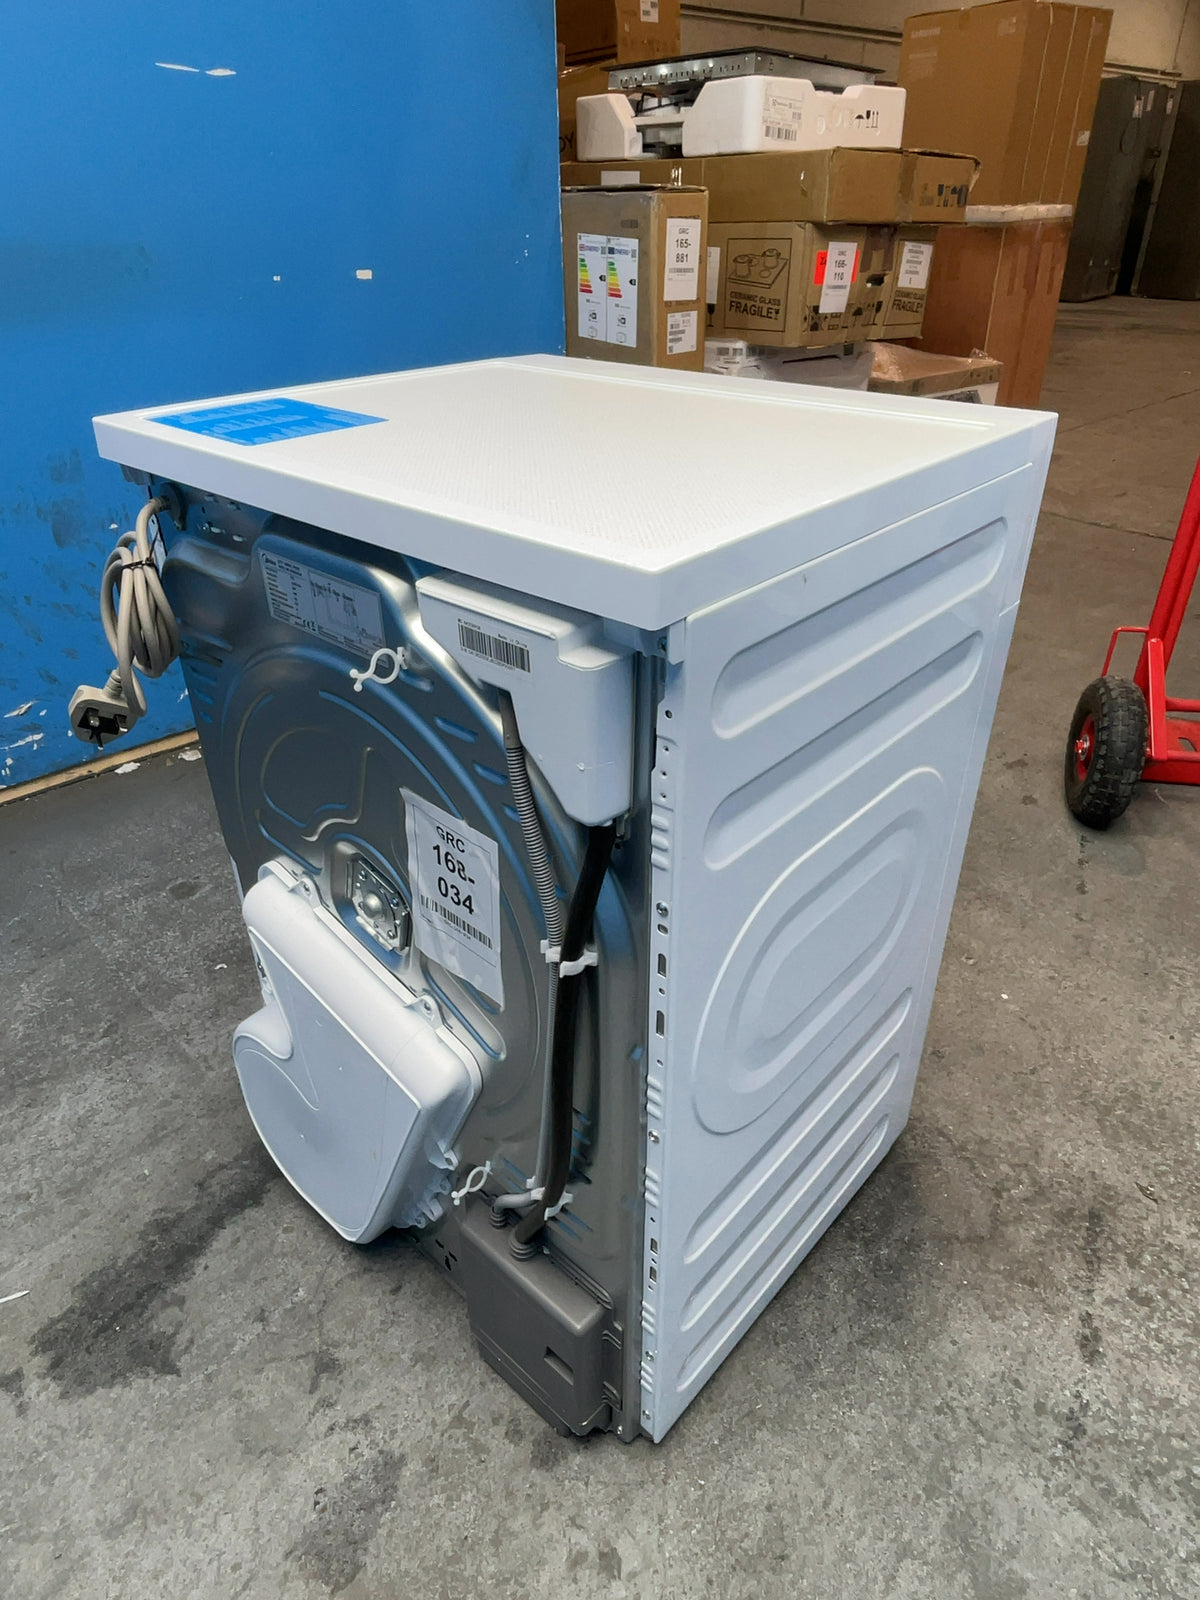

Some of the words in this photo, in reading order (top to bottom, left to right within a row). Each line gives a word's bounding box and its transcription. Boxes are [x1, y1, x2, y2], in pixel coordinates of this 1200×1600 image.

[675, 238, 692, 249] 165-
[675, 252, 690, 263] 881
[730, 290, 758, 303] CERAMIC
[759, 295, 782, 307] GLASS
[891, 299, 920, 314] FRAGILE
[729, 299, 774, 319] FRAGILE
[435, 825, 466, 854] GRC
[432, 843, 476, 885] 168-
[437, 875, 475, 915] 034
